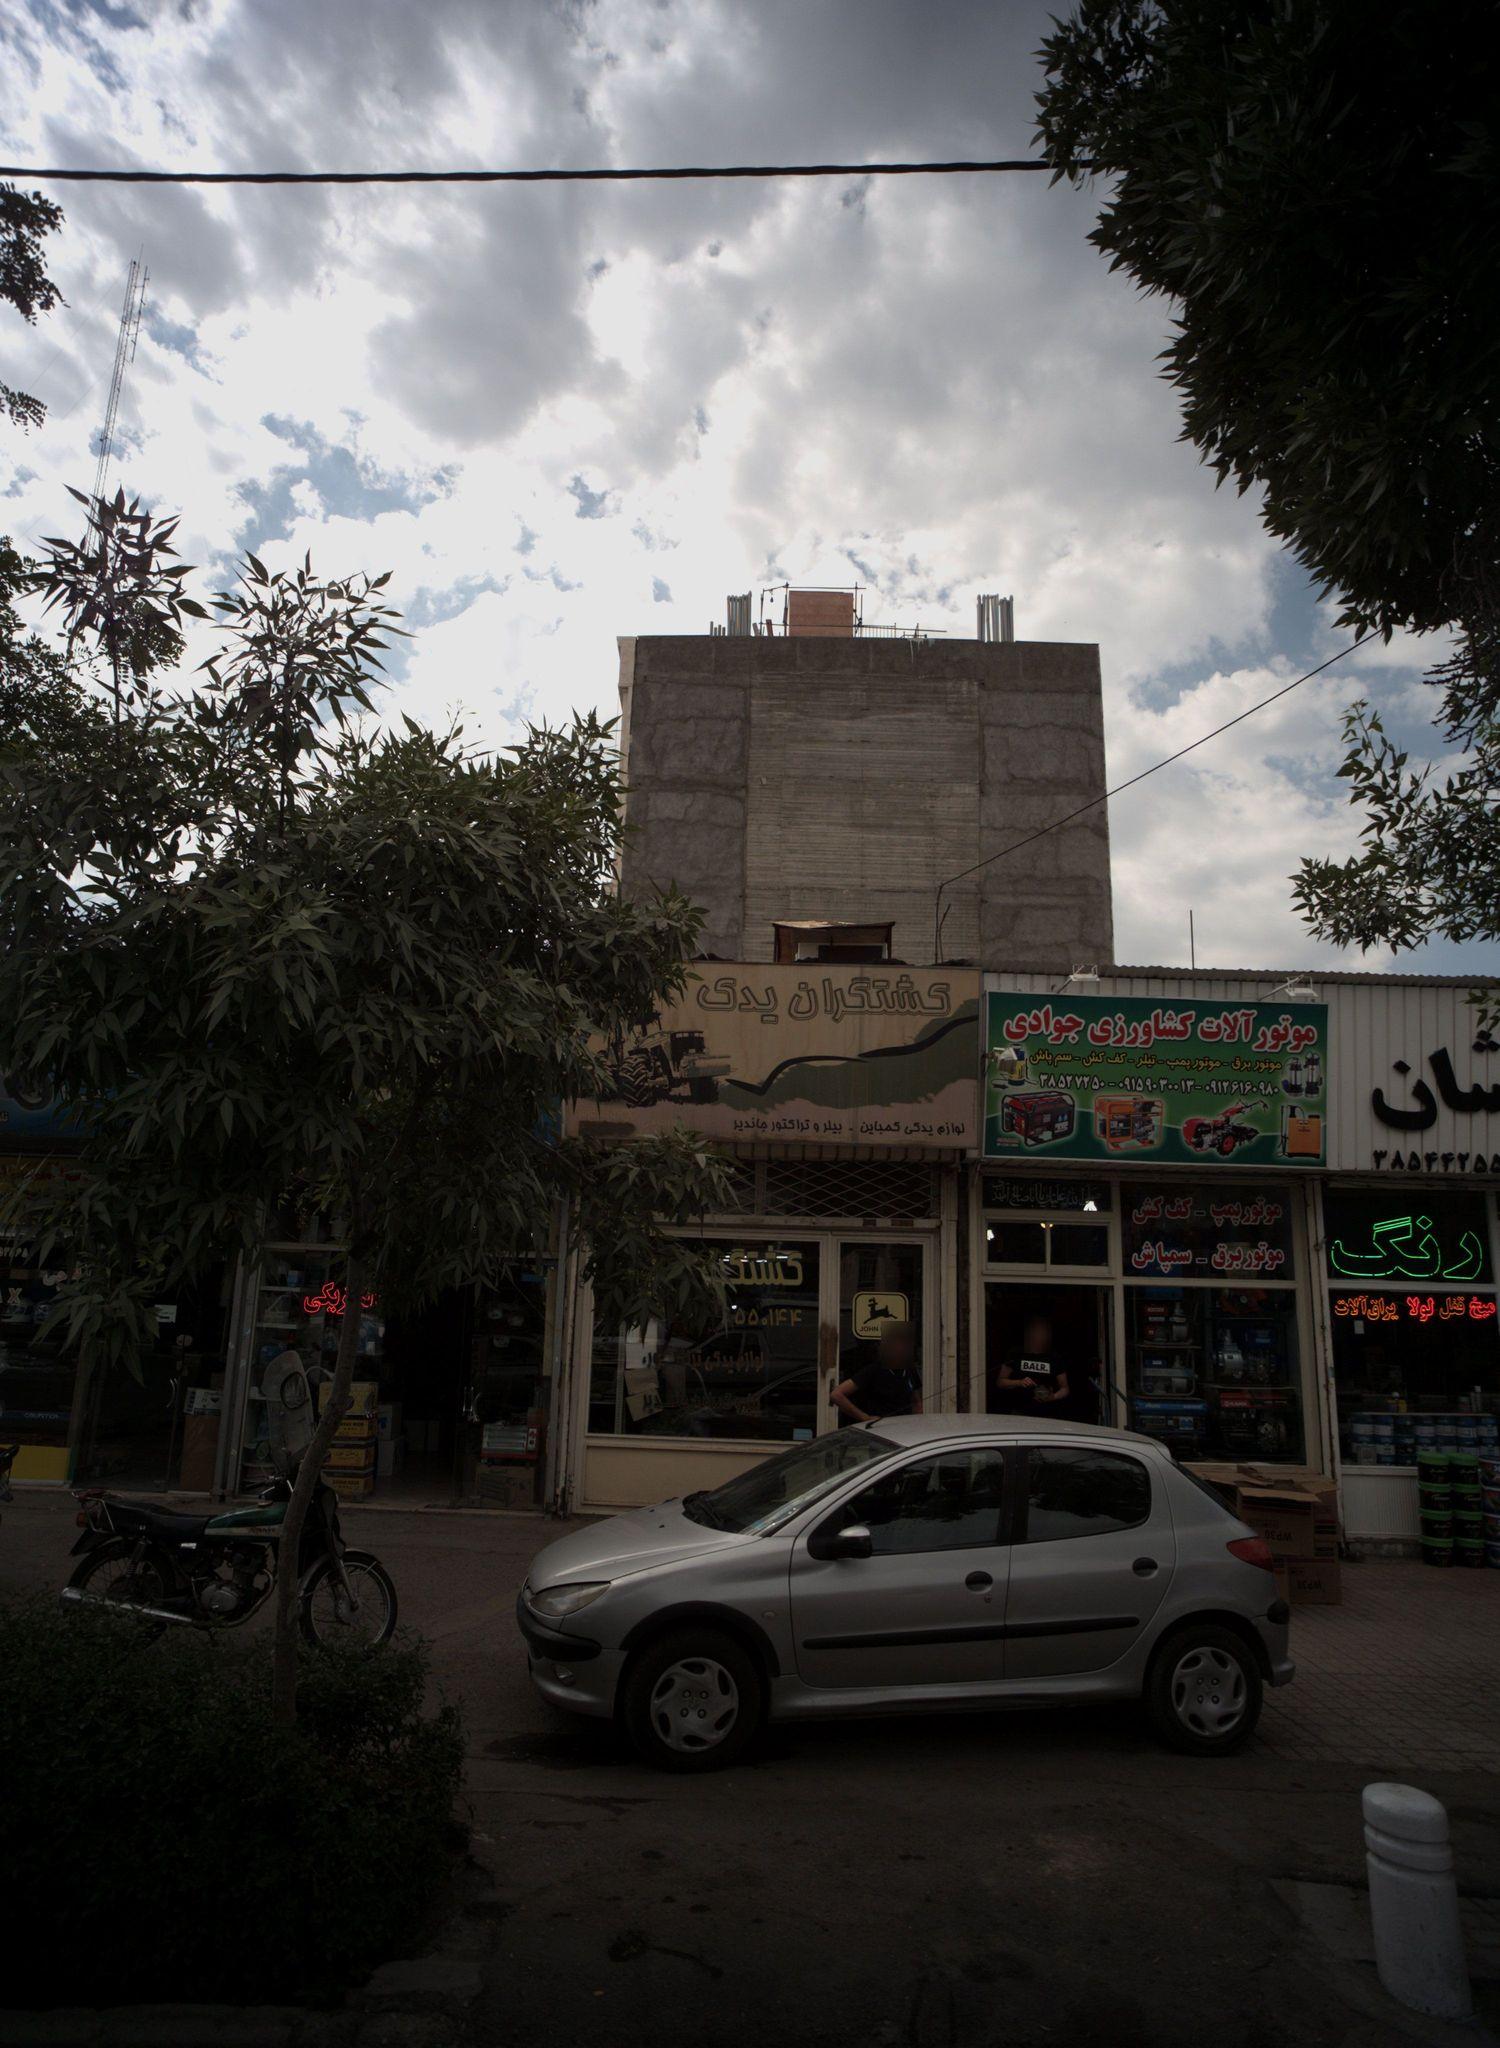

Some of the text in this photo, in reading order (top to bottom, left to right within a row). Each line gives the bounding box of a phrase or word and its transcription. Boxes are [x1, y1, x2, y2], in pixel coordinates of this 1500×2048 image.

[788, 974, 951, 1023] کشتگران
[1004, 1004, 1317, 1052] موتور آلات کشاورزی جوادی
[1082, 1052, 1104, 1067] کش
[1106, 1051, 1127, 1064] کف
[1192, 1056, 1220, 1072] موتور
[1232, 1056, 1251, 1071] برق
[1254, 1060, 1281, 1073] موتور
[769, 1118, 811, 1133] تراکتور
[860, 1119, 901, 1134] کمباین
[904, 1121, 934, 1136] یدکی
[937, 1120, 965, 1136] لوازم
[1131, 1196, 1163, 1225] کش
[1164, 1196, 1193, 1220] کف
[1209, 1201, 1242, 1226] پمپ
[1240, 1196, 1283, 1225] موتور
[1210, 1242, 1244, 1271] برق
[1243, 1241, 1286, 1272] موتور
[1331, 1215, 1483, 1280] رنگ
[1406, 1295, 1436, 1322] لولا
[1468, 1295, 1497, 1320] میخ
[859, 1325, 879, 1333] JOHN
[1022, 1361, 1049, 1373] BALR.
